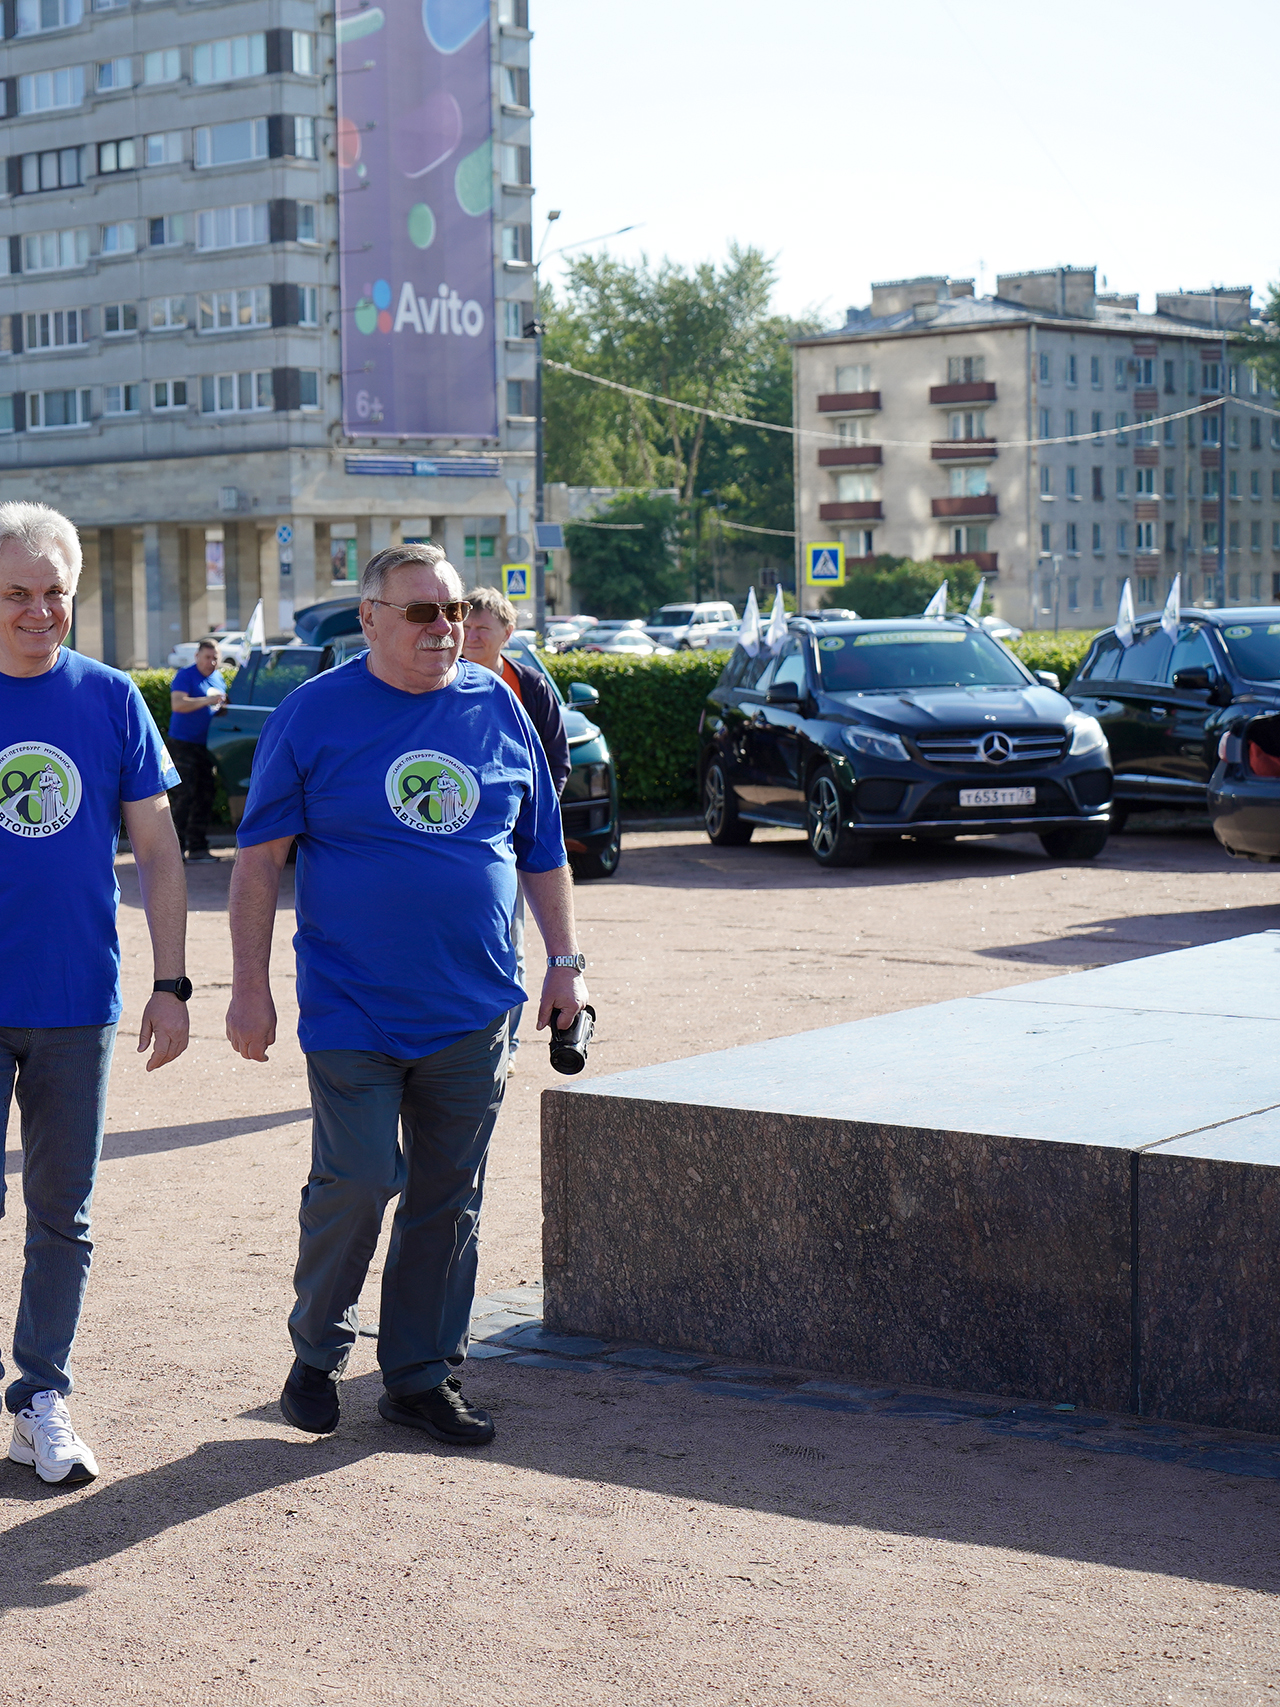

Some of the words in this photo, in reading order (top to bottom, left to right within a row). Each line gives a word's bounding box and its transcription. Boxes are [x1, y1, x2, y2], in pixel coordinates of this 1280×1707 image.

[393, 282, 484, 337] Avito
[43, 748, 71, 769] МУРМАНСК
[392, 753, 435, 775] САНКТ-ПЕТЕРБУРГ
[437, 755, 466, 775] МУРМАНСК
[392, 805, 471, 833] АВТОПРОБЕГ
